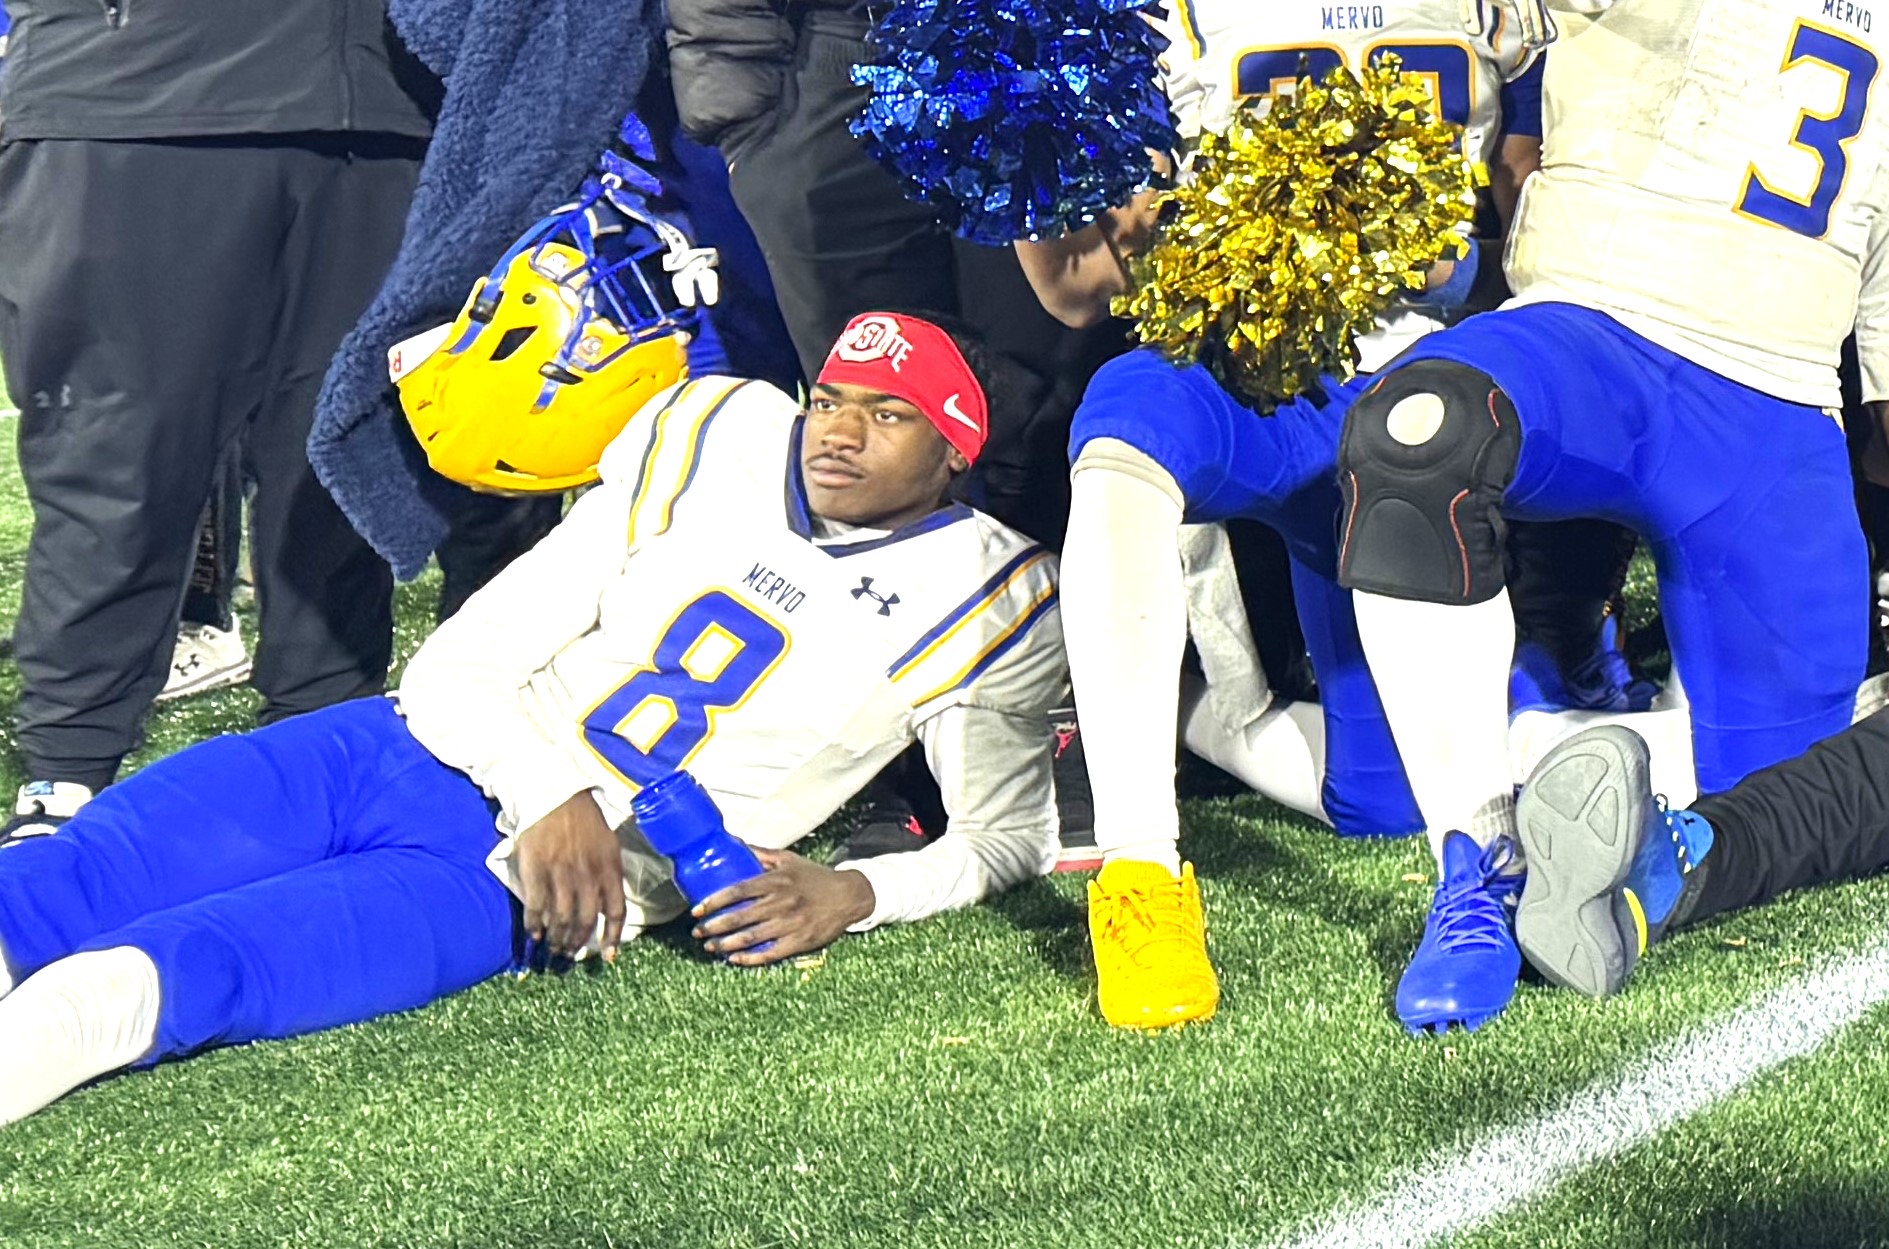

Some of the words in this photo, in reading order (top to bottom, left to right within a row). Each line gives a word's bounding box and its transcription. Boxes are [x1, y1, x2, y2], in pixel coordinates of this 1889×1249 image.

[1321, 5, 1384, 31] MERVO
[1731, 16, 1883, 240] 3
[741, 562, 807, 614] MERVO
[577, 583, 793, 795] 8
